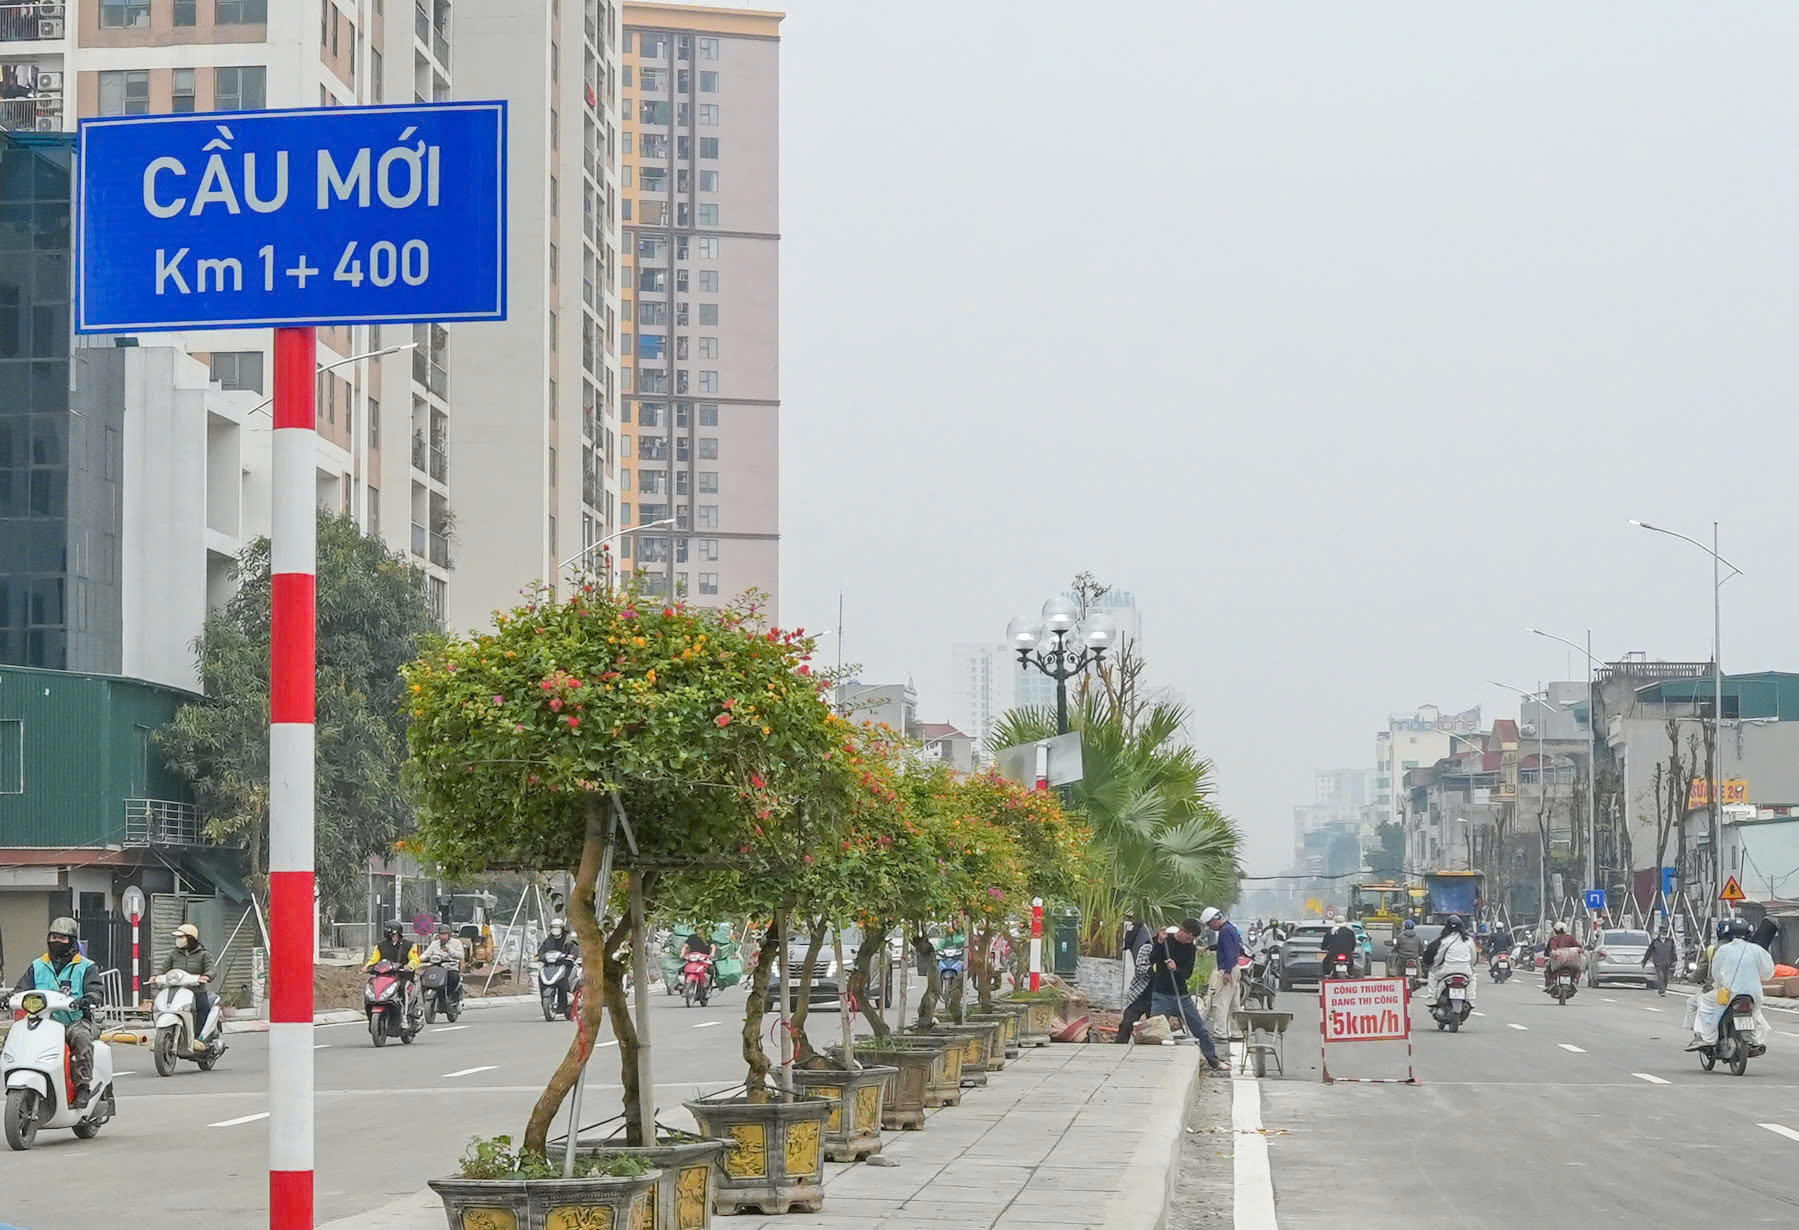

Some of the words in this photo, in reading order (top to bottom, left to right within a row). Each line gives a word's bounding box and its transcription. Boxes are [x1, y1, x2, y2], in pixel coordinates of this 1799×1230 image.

[143, 125, 288, 218] CẦU
[316, 126, 440, 209] MỚI
[155, 247, 243, 296] Km
[1331, 998, 1356, 1006] ĐANG
[1374, 995, 1398, 1004] CÔNG
[1334, 985, 1358, 994] CÔNG
[1332, 1010, 1399, 1035] 5km/h
